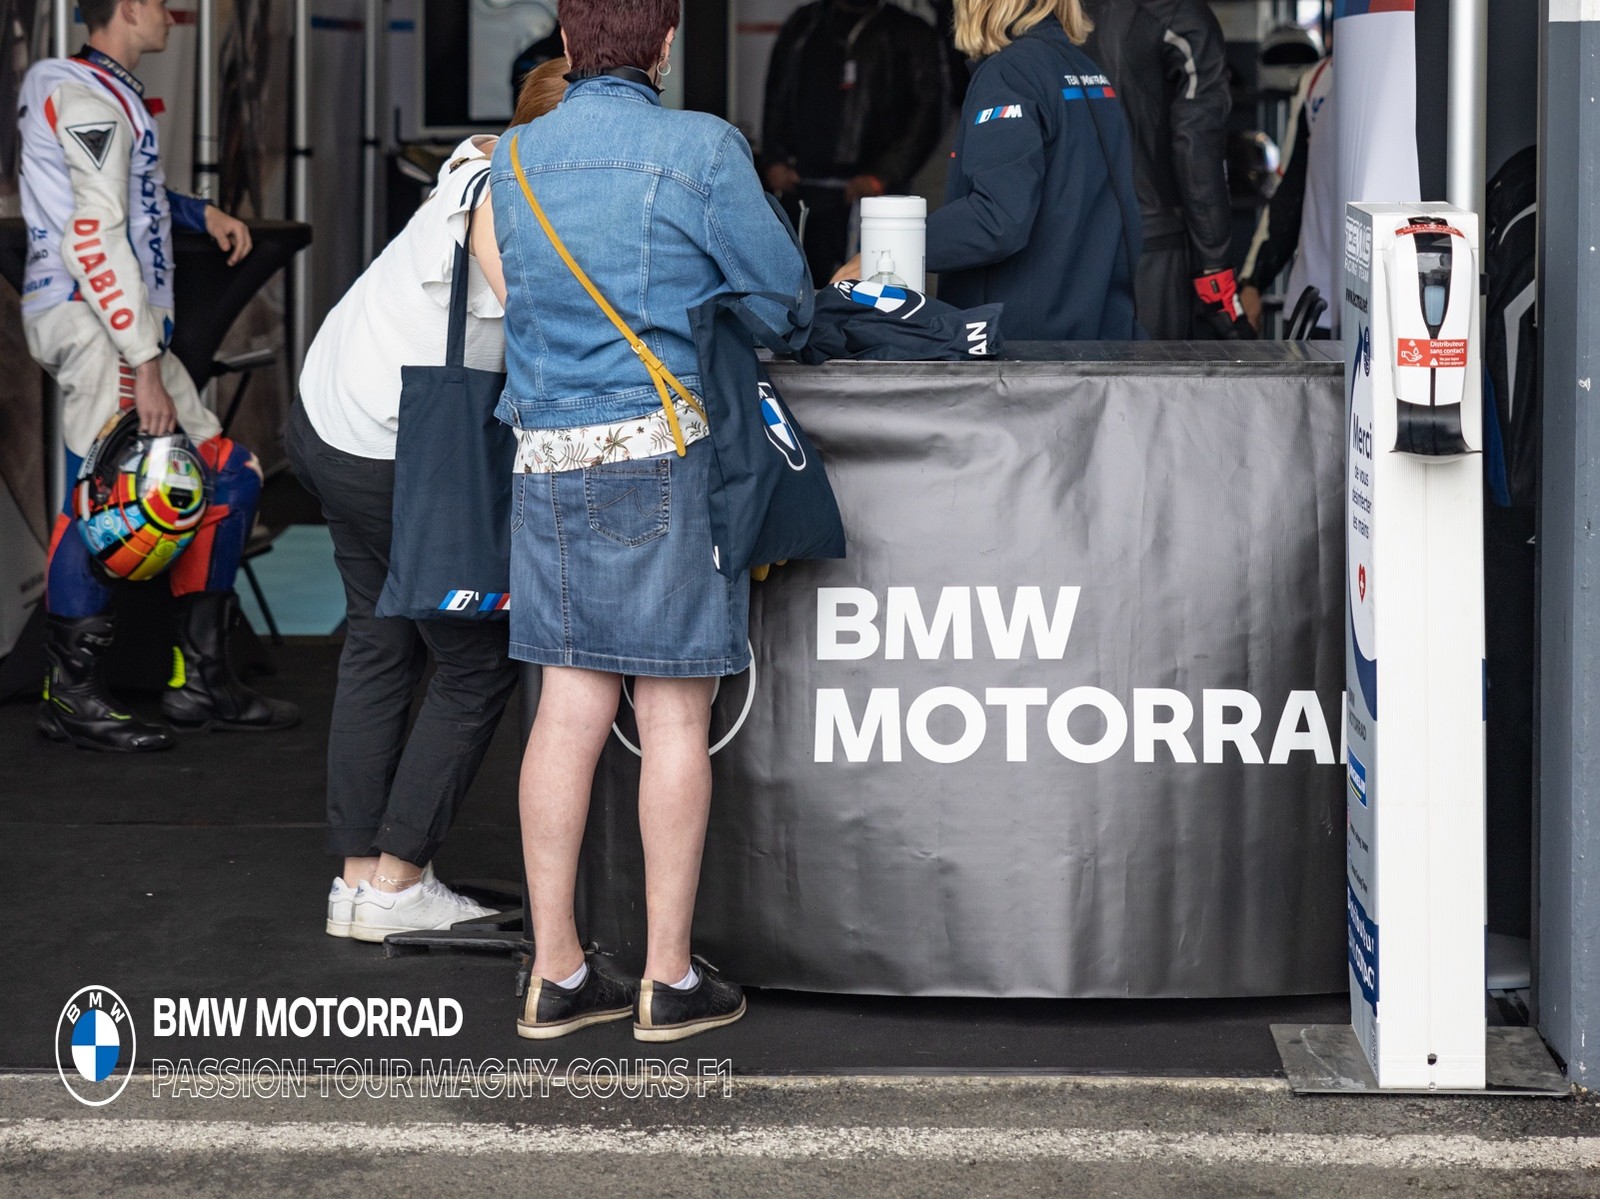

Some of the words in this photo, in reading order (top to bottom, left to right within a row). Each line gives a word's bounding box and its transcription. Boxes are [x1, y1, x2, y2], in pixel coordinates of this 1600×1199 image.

[73, 218, 135, 331] DIABLO
[1352, 412, 1373, 460] Merci
[816, 585, 1081, 661] BMW
[813, 685, 1348, 765] MOTORRA
